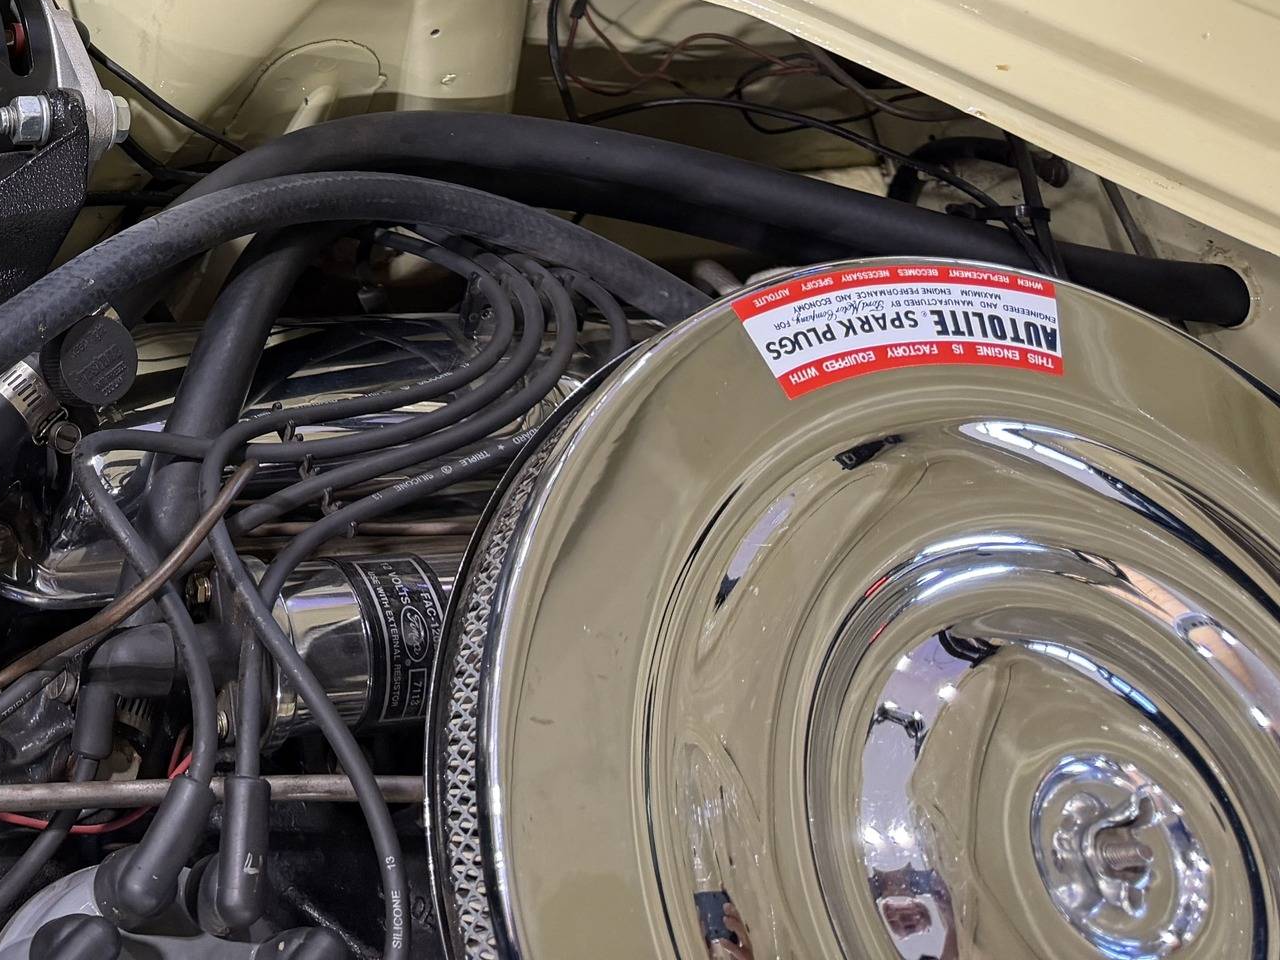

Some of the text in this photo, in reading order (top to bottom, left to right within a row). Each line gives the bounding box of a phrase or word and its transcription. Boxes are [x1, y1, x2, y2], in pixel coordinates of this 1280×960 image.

[752, 268, 1043, 308] WHEN REPLACEMENT BECOMES NECESSARY SPECIFY AUTOLITE
[856, 287, 920, 299] PERFORMANCE
[960, 289, 1001, 300] MAXIMUM
[793, 298, 832, 314] ECONOMY
[835, 294, 852, 302] AND
[860, 300, 884, 312] Ford
[904, 298, 973, 307] MANUFACTURED
[980, 301, 998, 309] AND
[836, 302, 860, 316] Motor
[1003, 304, 1056, 324] ENGINEERED
[773, 321, 791, 330] FOR
[765, 309, 1057, 360] AUTOLITE SPARK PLUGS
[788, 343, 1054, 385] THIS ENGINE IS FACTORY EQUIPPED WITH
[458, 450, 490, 466] TRIPLE
[394, 474, 434, 493] SILICONE
[390, 572, 411, 604] VOLTS
[368, 571, 402, 707] USE WITH EXTERNAL RESISTOR
[386, 856, 403, 949] SILICONE 13
